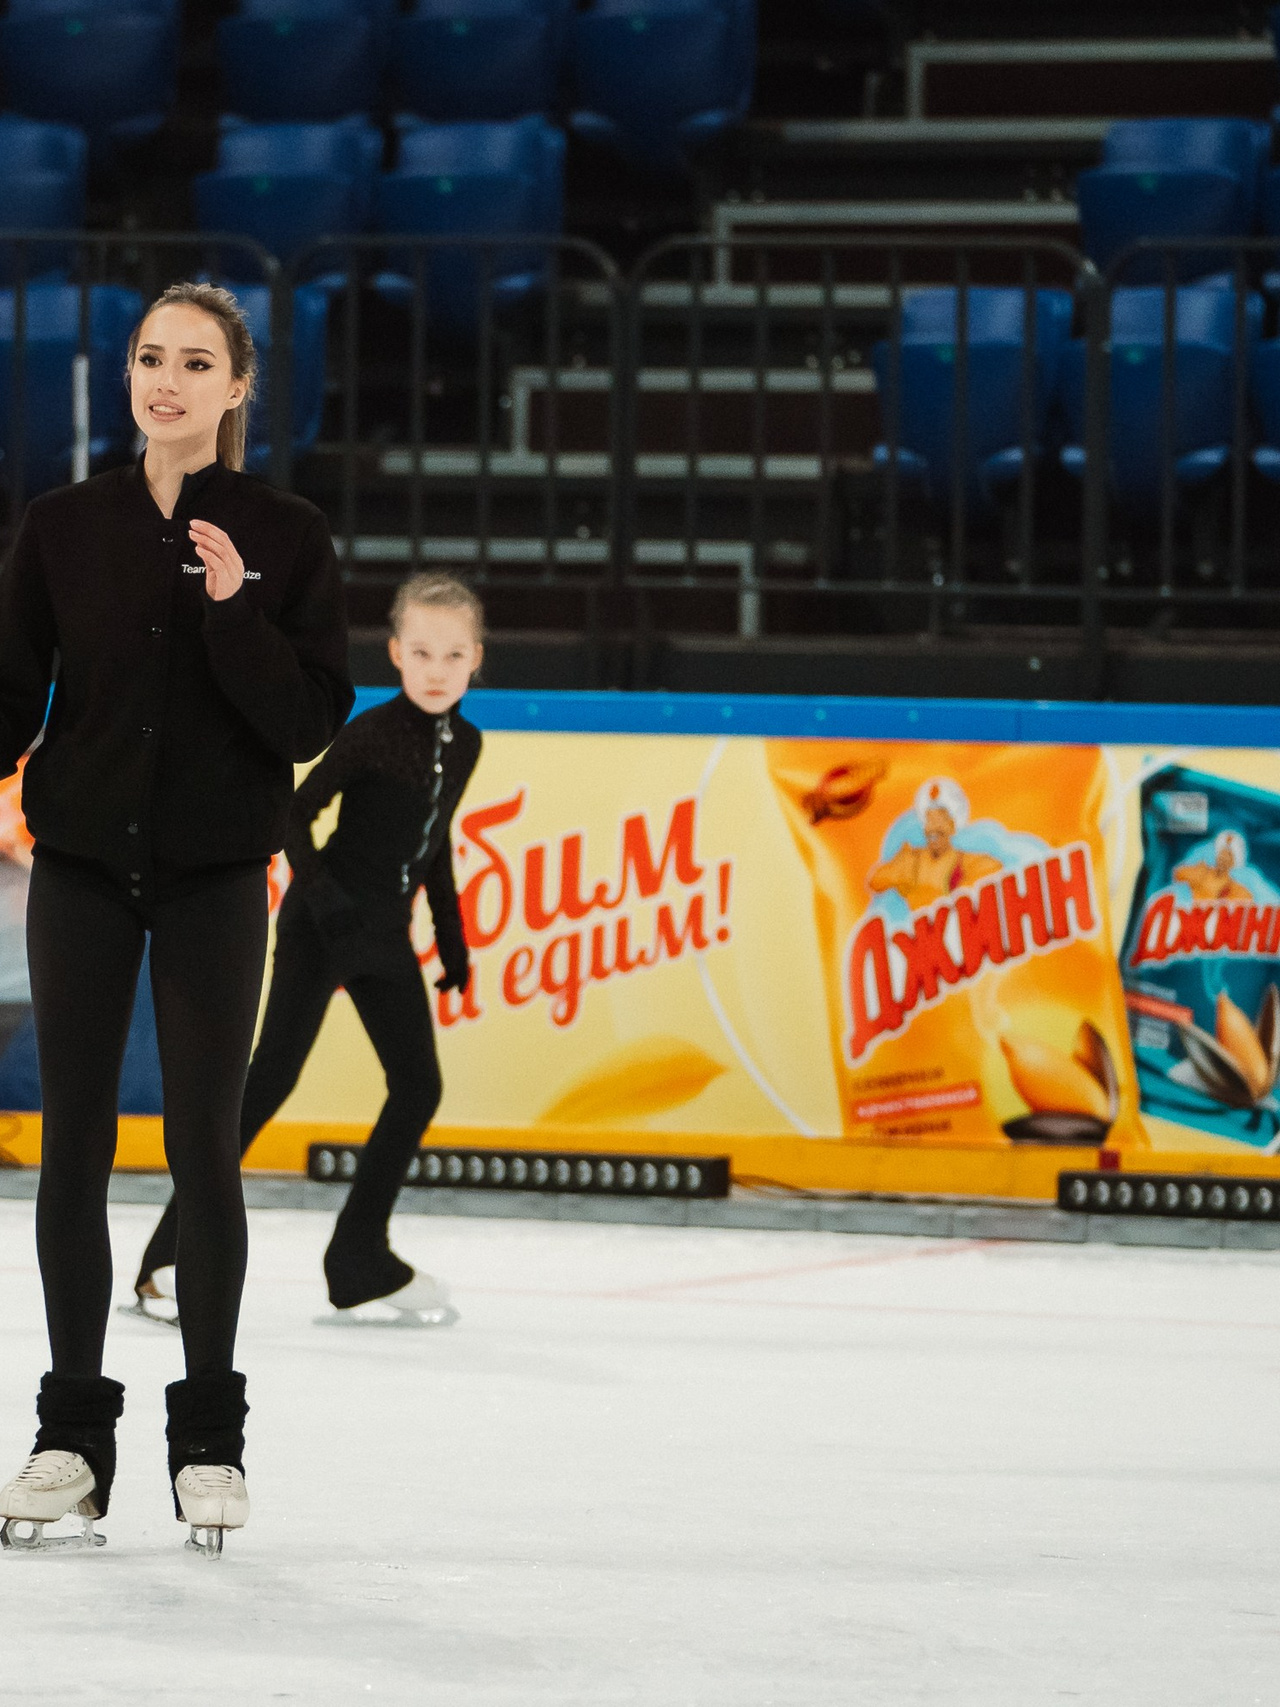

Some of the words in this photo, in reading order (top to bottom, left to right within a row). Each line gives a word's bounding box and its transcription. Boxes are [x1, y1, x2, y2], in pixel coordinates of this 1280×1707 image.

[417, 786, 704, 966] бим
[503, 862, 732, 1028] едим!
[850, 848, 1095, 1060] ДЖИНН
